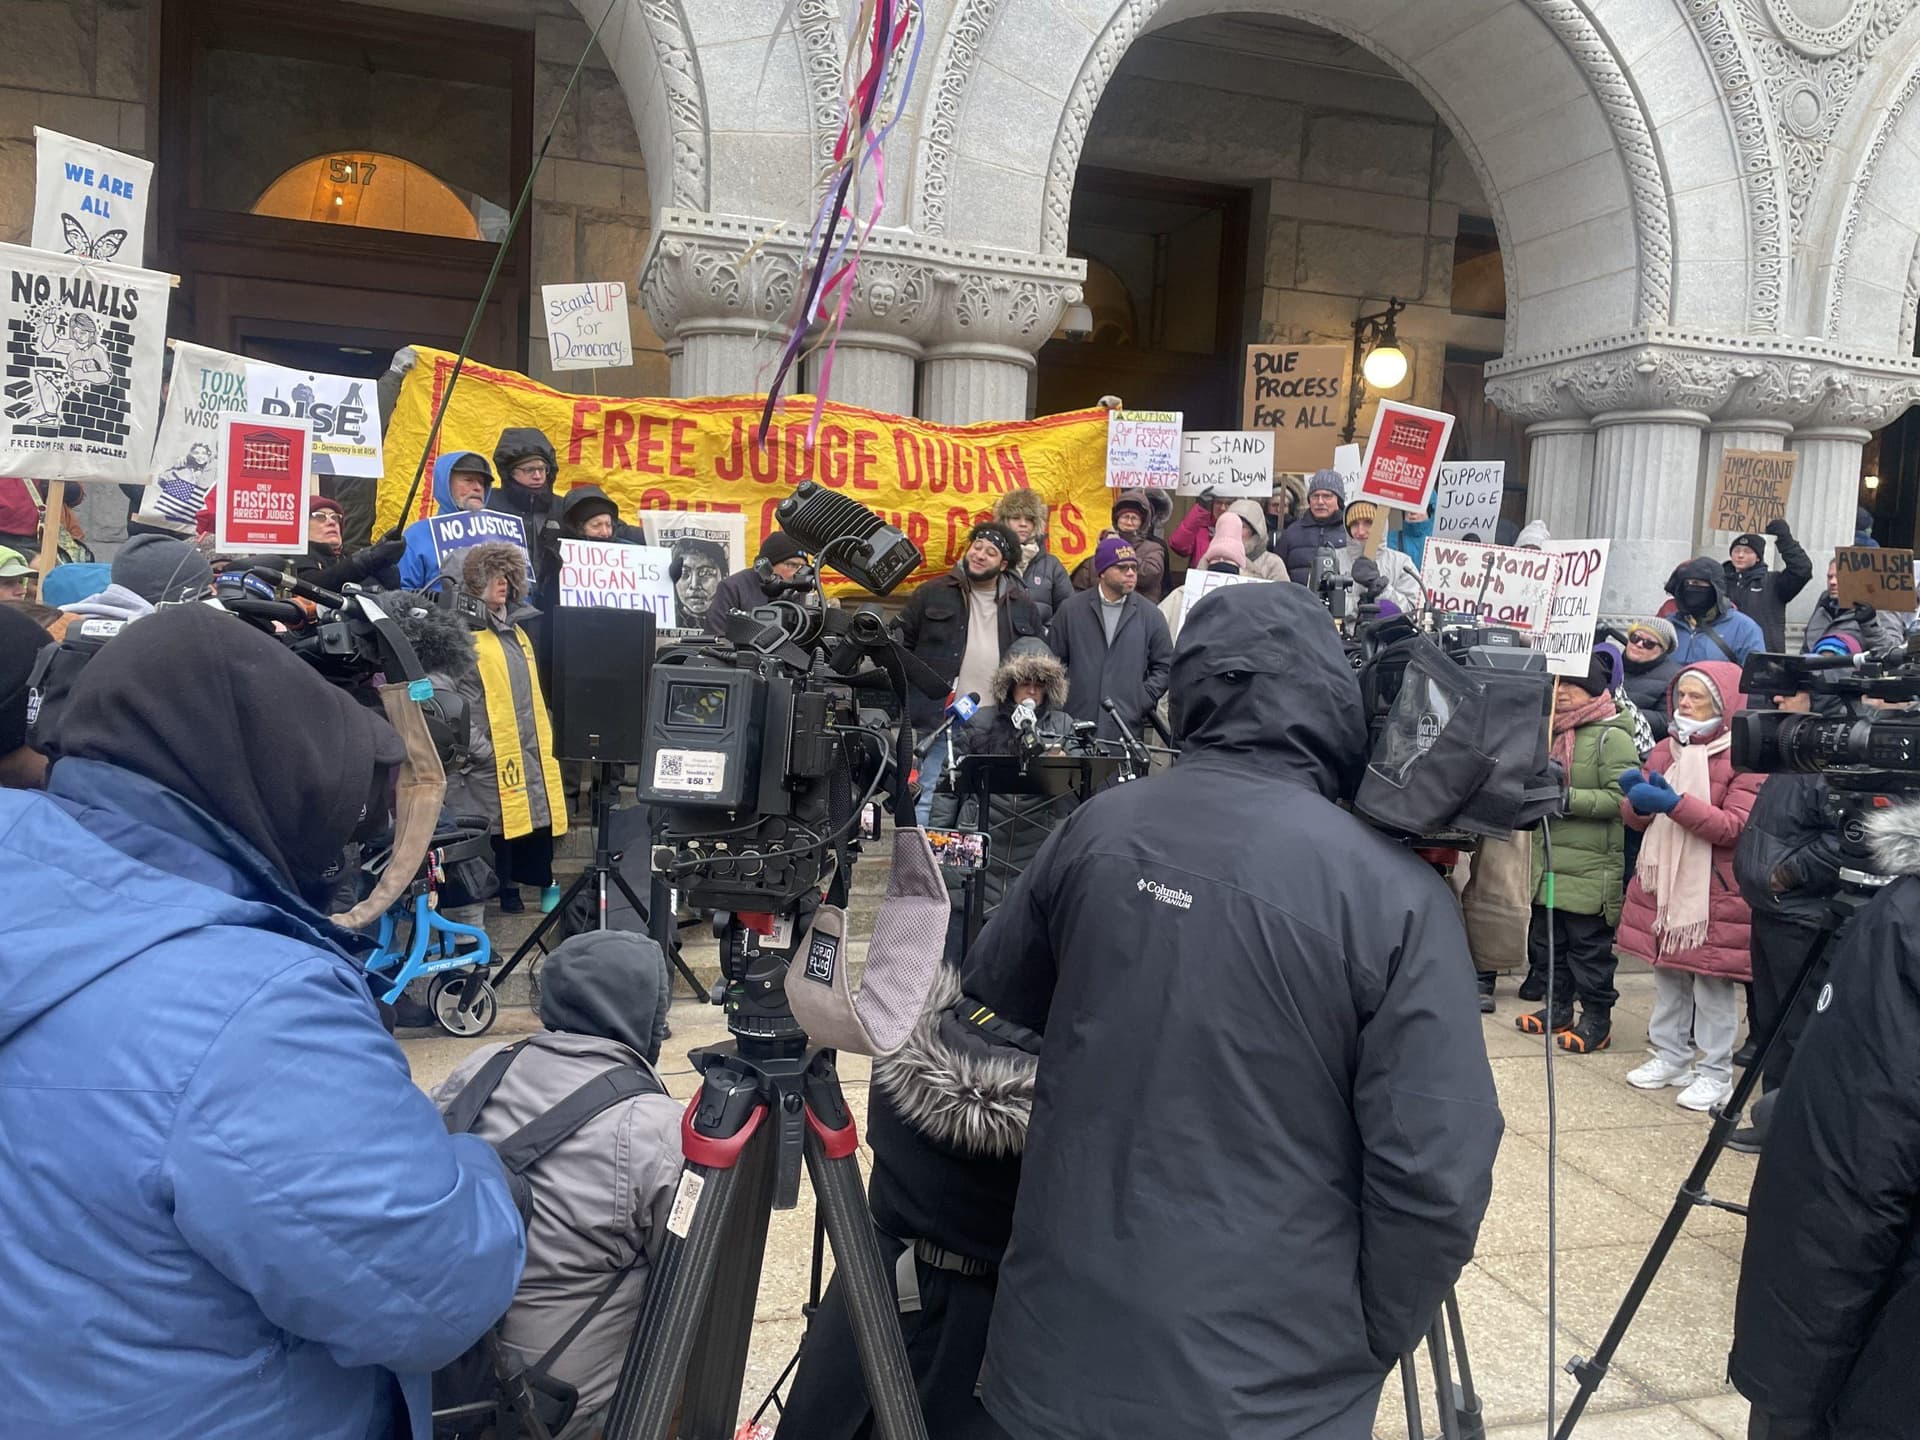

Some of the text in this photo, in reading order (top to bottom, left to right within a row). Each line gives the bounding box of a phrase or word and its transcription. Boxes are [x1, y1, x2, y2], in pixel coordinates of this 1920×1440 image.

[65, 162, 134, 200] WE ARE
[330, 159, 377, 185] 517
[80, 195, 110, 219] ALL
[11, 270, 139, 320] NO WALLS
[551, 283, 623, 317] Stand UP
[576, 316, 602, 337] for
[551, 332, 622, 366] Democracy
[1253, 352, 1299, 375] DUE
[200, 368, 246, 398] TODX
[1255, 376, 1338, 401] PROCESS
[1127, 411, 1173, 422] CAUTION
[1295, 405, 1337, 429] ALL
[10, 439, 51, 451] FREEDOM
[52, 441, 65, 452] FOR
[69, 443, 83, 453] OUR
[321, 443, 350, 455] Democracy
[568, 402, 1031, 495] FREE JUDGE DUGAN
[1111, 434, 1129, 447] AT
[1183, 437, 1201, 454] I
[1208, 455, 1233, 465] with
[1374, 456, 1427, 480] FASCISTS
[1441, 467, 1501, 486] SUPPORT
[1724, 475, 1783, 501] WELCOME
[233, 490, 295, 510] FASCISTS
[1441, 490, 1500, 509] JUDGE
[1718, 495, 1744, 513] DUE
[233, 508, 295, 521] ARREST JUDGES
[1440, 514, 1496, 531] DUGAN
[1719, 512, 1746, 532] FOR
[440, 519, 464, 541] NO
[562, 543, 633, 570] JUDGE
[1838, 551, 1914, 573] ABOLISH
[561, 562, 660, 591] DUGAN IS
[1880, 574, 1914, 591] ICE
[561, 588, 670, 623] INNOCENT
[1551, 596, 1591, 617] DICIAL
[1147, 881, 1193, 904] Columbia
[1155, 894, 1191, 909] TITANIUM
